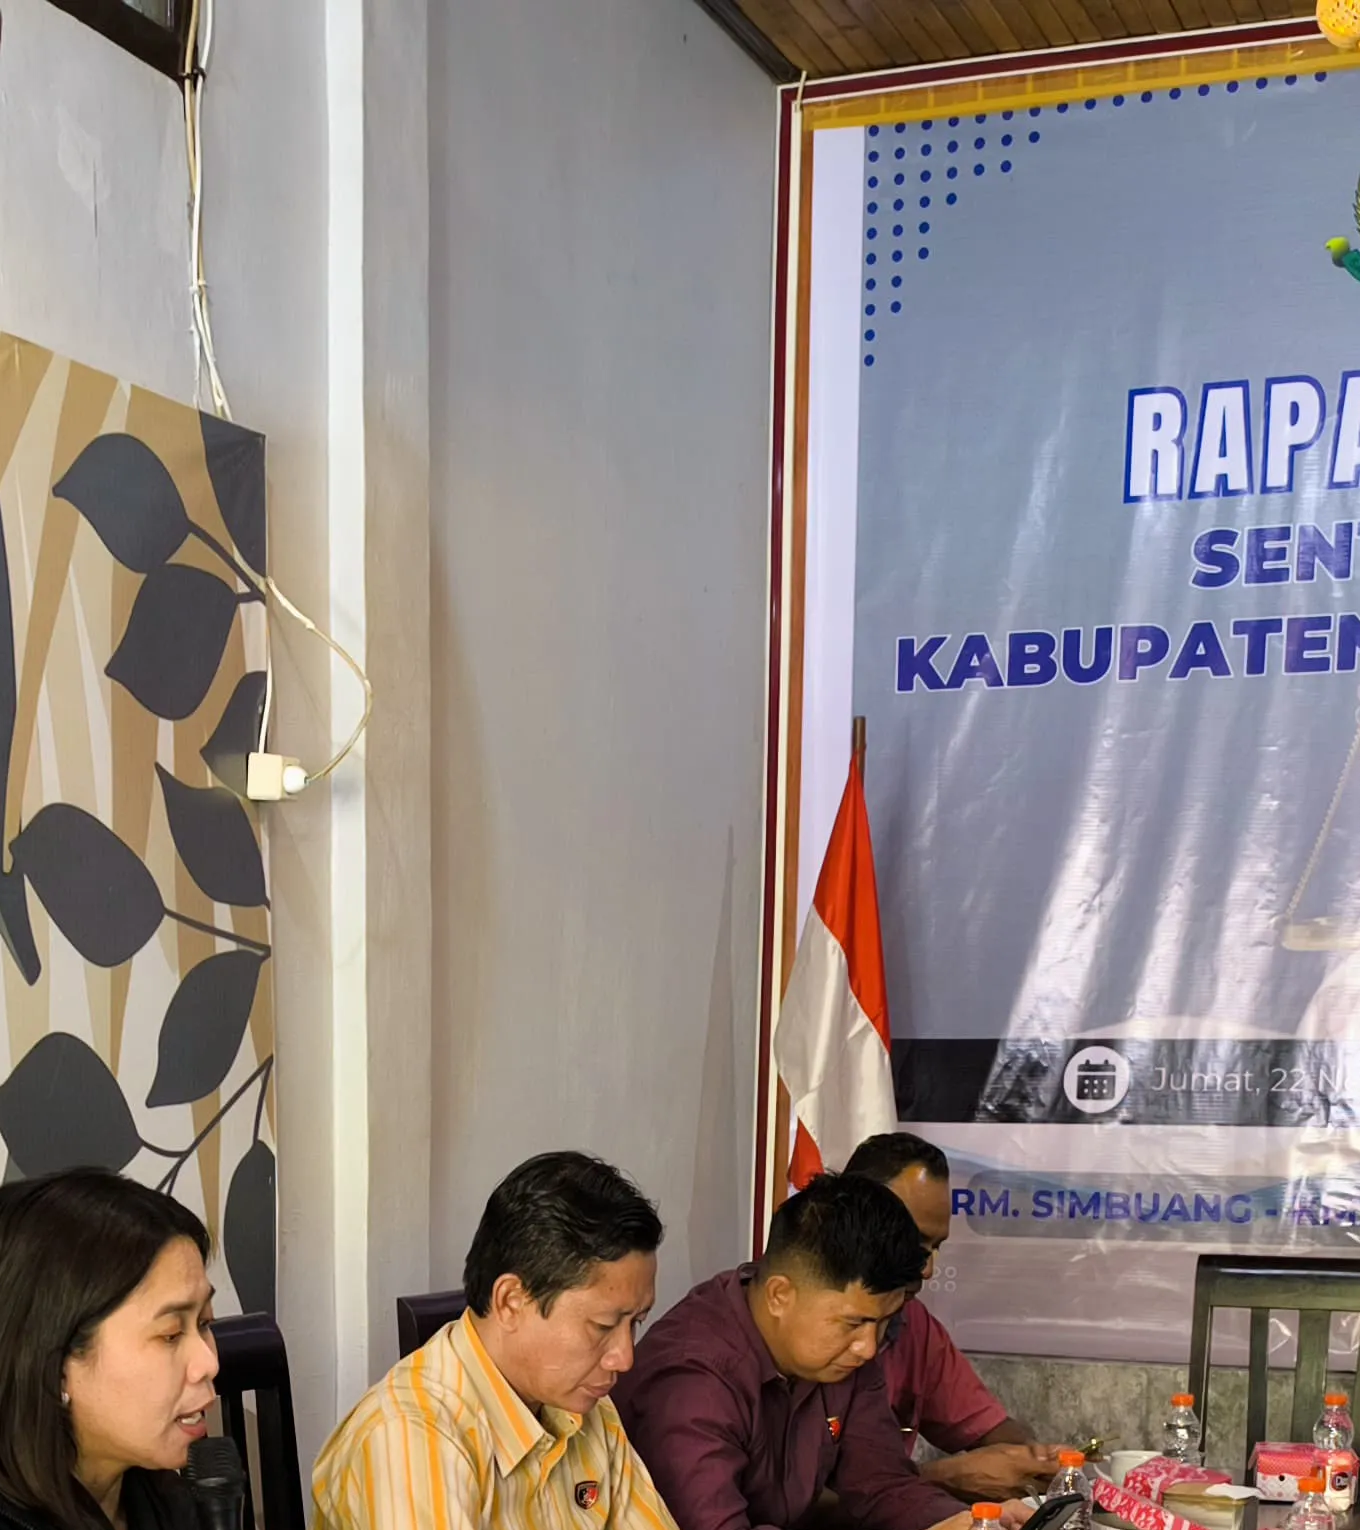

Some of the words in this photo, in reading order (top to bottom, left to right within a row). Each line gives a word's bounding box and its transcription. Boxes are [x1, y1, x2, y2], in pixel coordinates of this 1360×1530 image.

[1151, 1066, 1261, 1096] Jumat,
[1270, 1068, 1306, 1093] 22
[951, 1188, 1019, 1218] RM.
[1031, 1190, 1253, 1224] SIMBUANG
